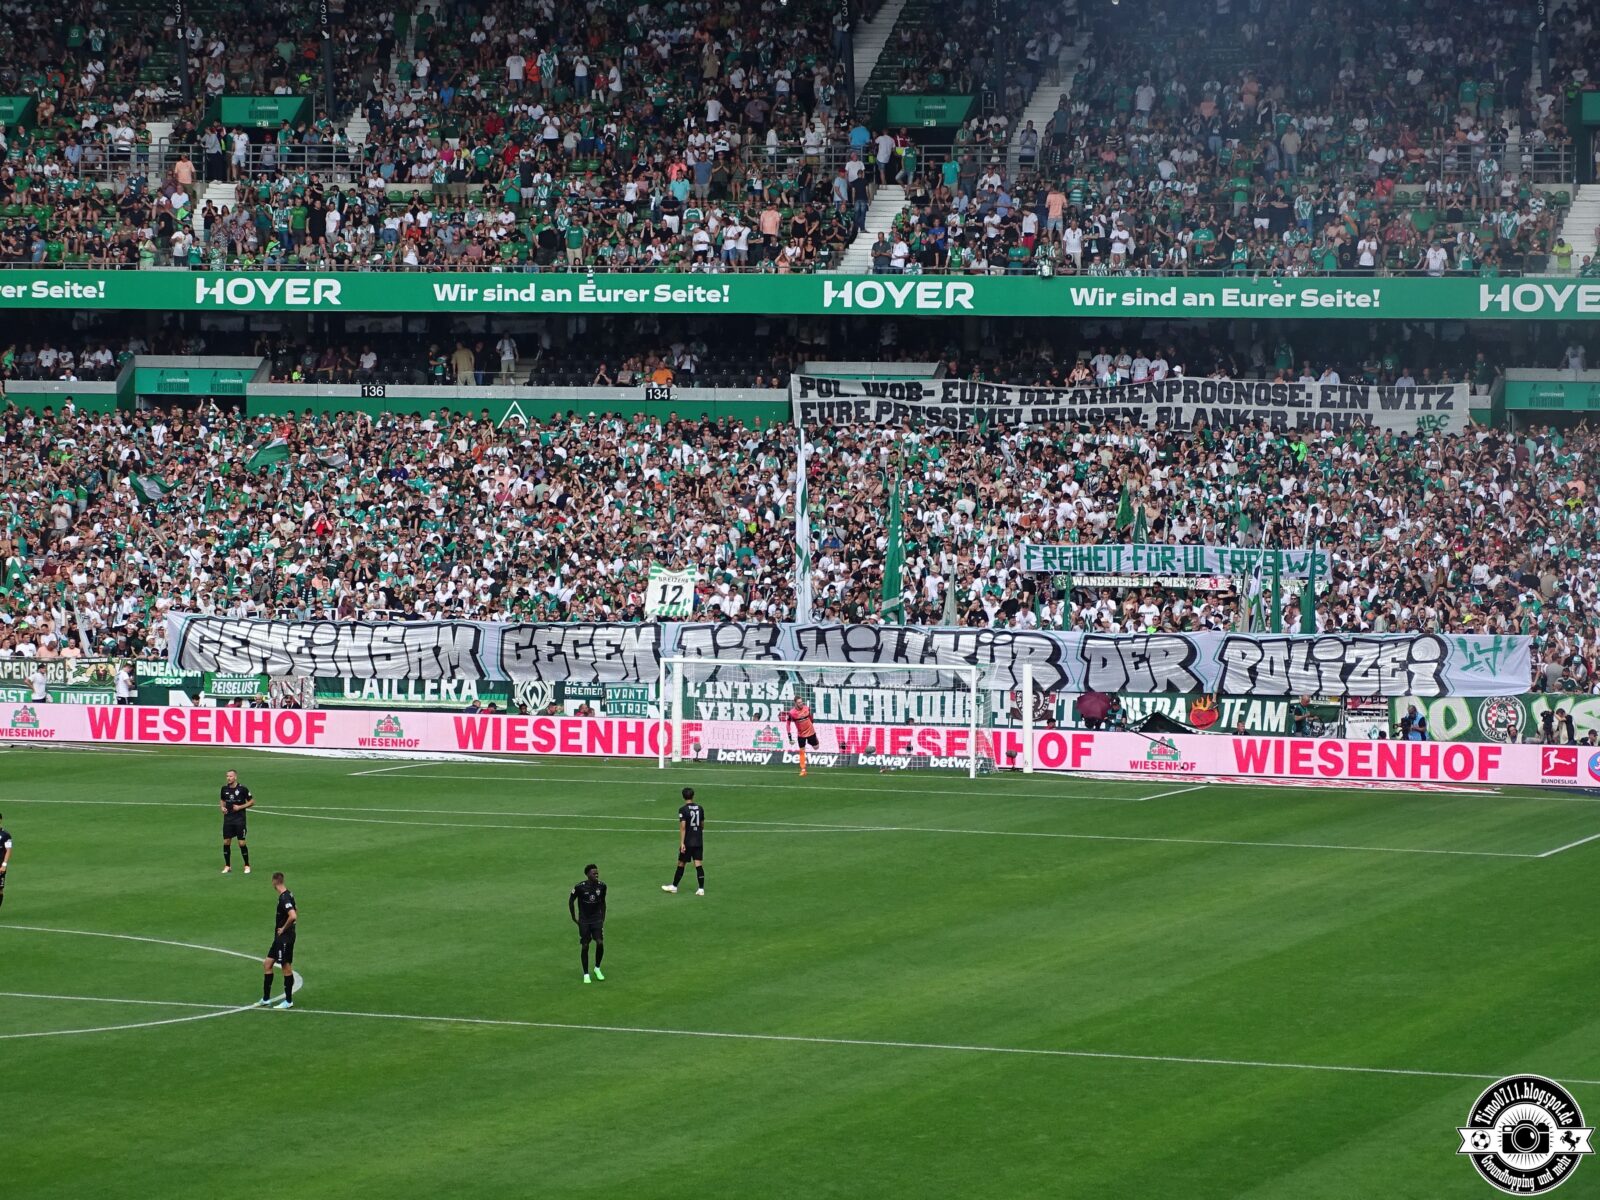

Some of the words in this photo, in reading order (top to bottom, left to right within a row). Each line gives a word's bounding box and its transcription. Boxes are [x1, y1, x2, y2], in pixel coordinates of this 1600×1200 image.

[31, 281, 105, 299] Seite!
[195, 277, 342, 305] HOYER
[433, 283, 479, 302] Wir
[484, 282, 536, 302] sind
[541, 288, 572, 302] an
[579, 284, 650, 302] Eurer
[654, 282, 730, 303] Seite!
[823, 280, 975, 309] HOYER
[1070, 286, 1117, 306] Wir
[1122, 286, 1177, 306] sind
[1182, 292, 1215, 307] an
[1222, 287, 1297, 308] Eurer
[1301, 287, 1381, 308] Seite!
[363, 386, 384, 397] 136
[647, 388, 669, 400] 134
[941, 381, 1012, 406] EURE
[1019, 379, 1313, 408] GEFAHRENPROGNOSE:
[1320, 384, 1369, 410] EIN
[1377, 386, 1454, 411] WITZ
[800, 401, 871, 426] EURE
[1072, 576, 1140, 587] WANDERERS
[658, 584, 684, 606] 12
[1082, 633, 1204, 694] DER
[155, 677, 182, 685] 3000
[211, 680, 261, 694] REISELUST
[343, 675, 479, 702] CAILLERA
[606, 688, 648, 701] AVANTI
[606, 702, 648, 715] ULTRAS
[1220, 698, 1289, 733] TEAM
[87, 706, 327, 745] WIESENHOF
[358, 736, 420, 748] WIESENHOF
[453, 715, 703, 757] WIESENHOF
[717, 749, 773, 764] betway
[857, 753, 911, 769] betway
[1129, 760, 1197, 772] WIESENHOF
[1232, 738, 1502, 781] WIESENHOF
[689, 810, 700, 827] 21
